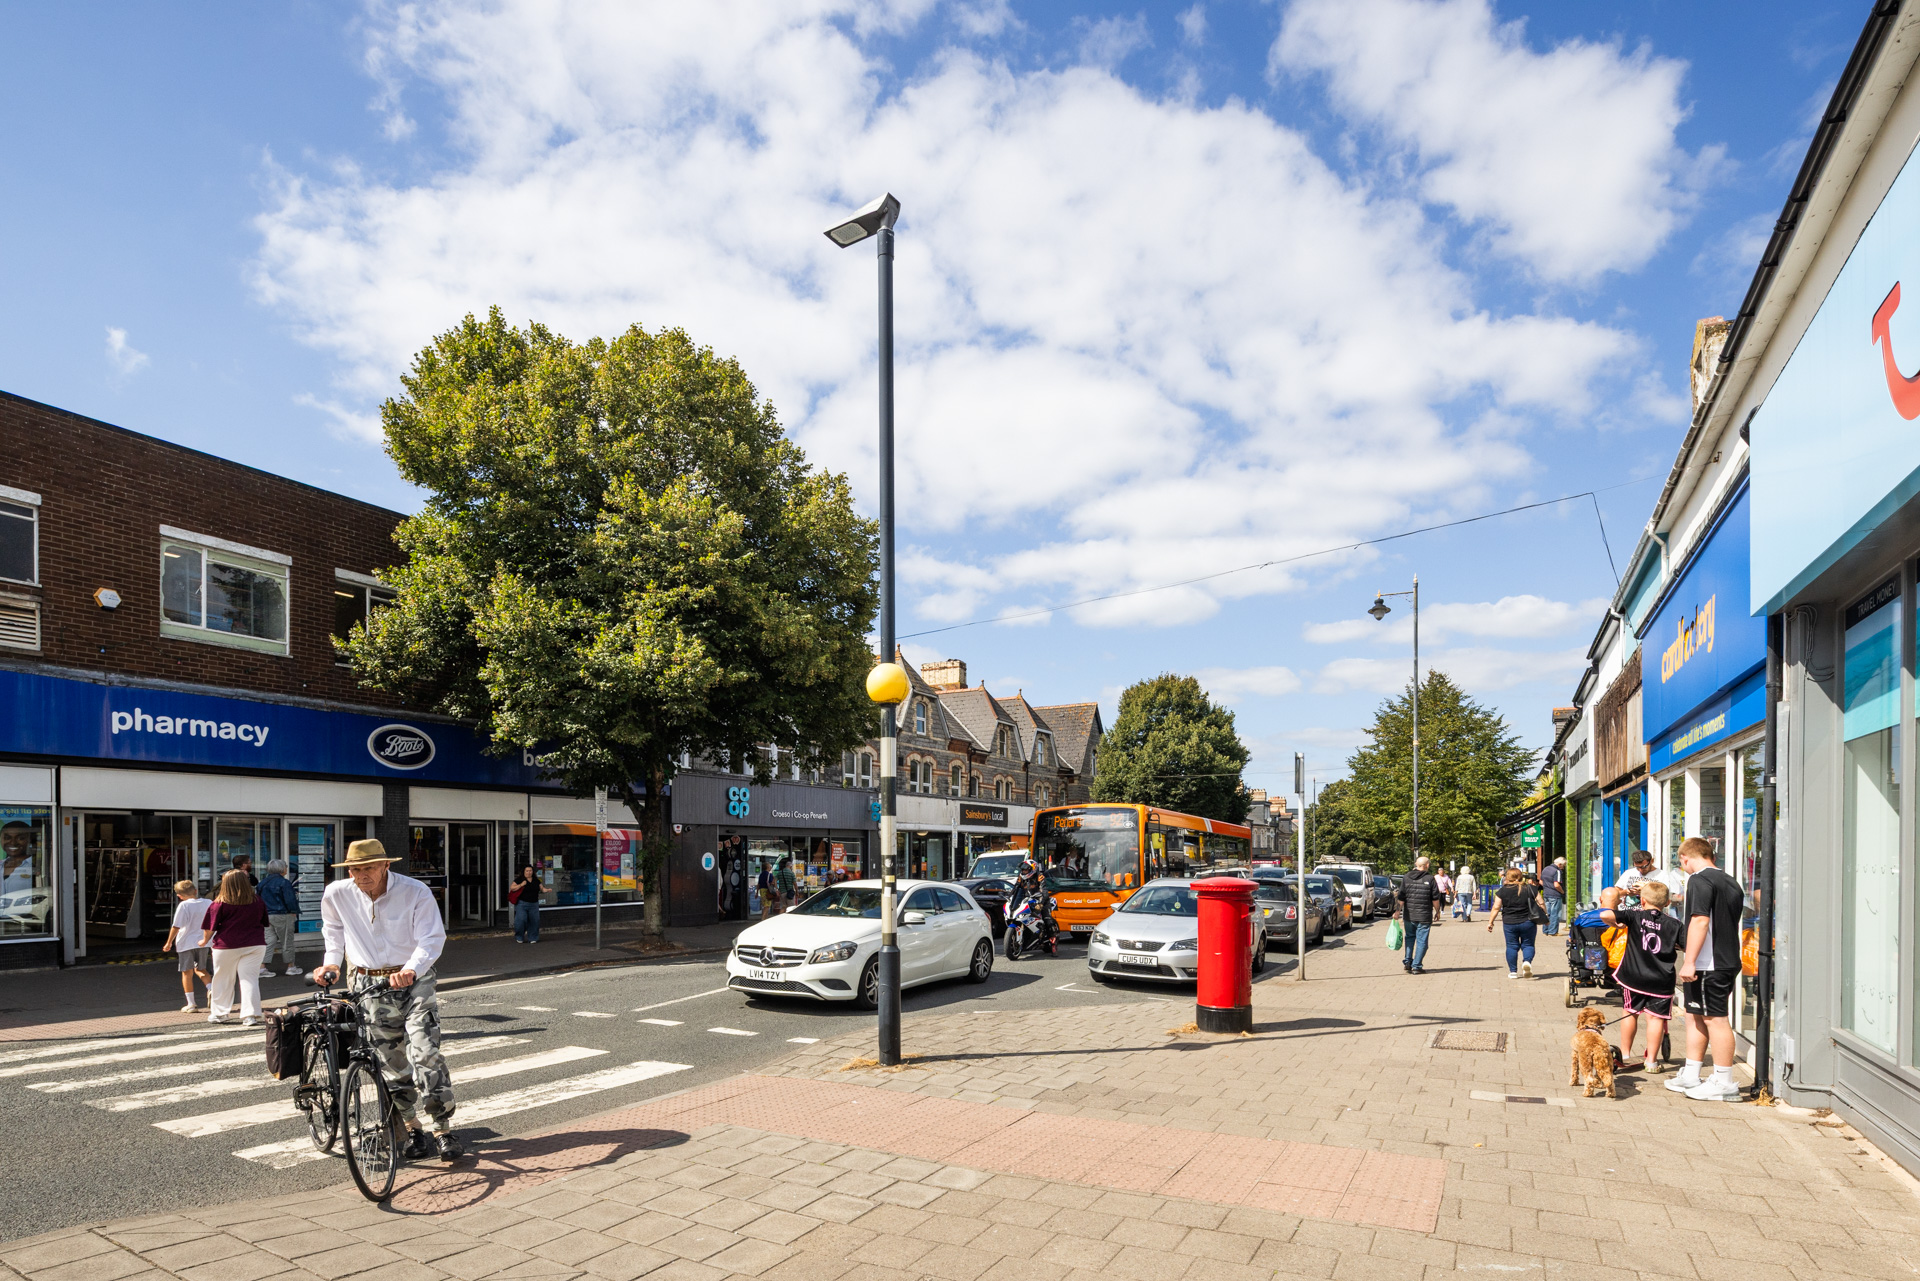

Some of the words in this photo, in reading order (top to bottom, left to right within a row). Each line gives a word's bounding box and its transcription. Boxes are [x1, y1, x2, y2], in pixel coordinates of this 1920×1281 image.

[1857, 596, 1876, 618] TRAVEL
[1876, 580, 1896, 605] MONEY
[111, 707, 269, 747] pharmacy
[1702, 710, 1726, 739] moments
[380, 734, 425, 758] Boots
[772, 809, 791, 818] Croeso
[794, 810, 810, 821] Co-op
[809, 811, 828, 820] Penarth
[965, 809, 992, 821] Sainsbury's
[991, 811, 1004, 821] Local
[1641, 918, 1662, 931] MESSI
[1641, 928, 1662, 954] 10
[1122, 955, 1138, 963] CU15
[749, 969, 765, 979] LV14
[766, 971, 780, 980] TZY
